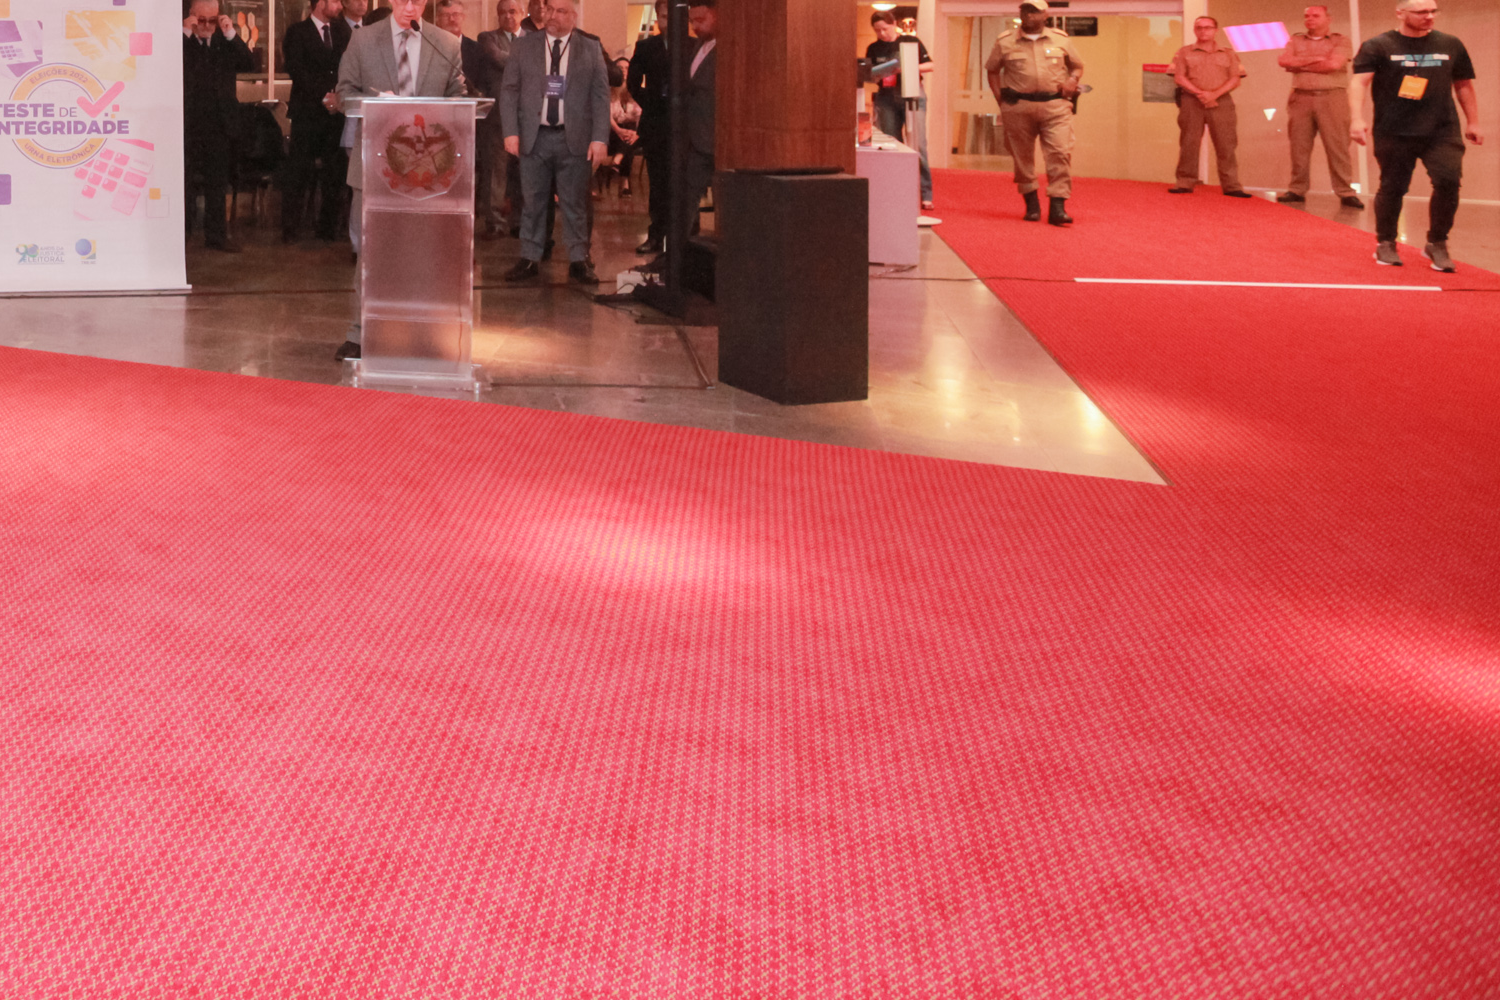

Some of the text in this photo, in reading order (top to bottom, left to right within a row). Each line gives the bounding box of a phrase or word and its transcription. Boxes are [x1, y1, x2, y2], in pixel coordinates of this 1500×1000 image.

[29, 68, 89, 85] ELEIÇÕES 2022
[59, 107, 78, 118] DE
[24, 142, 96, 164] URNA ELETRÔNICA
